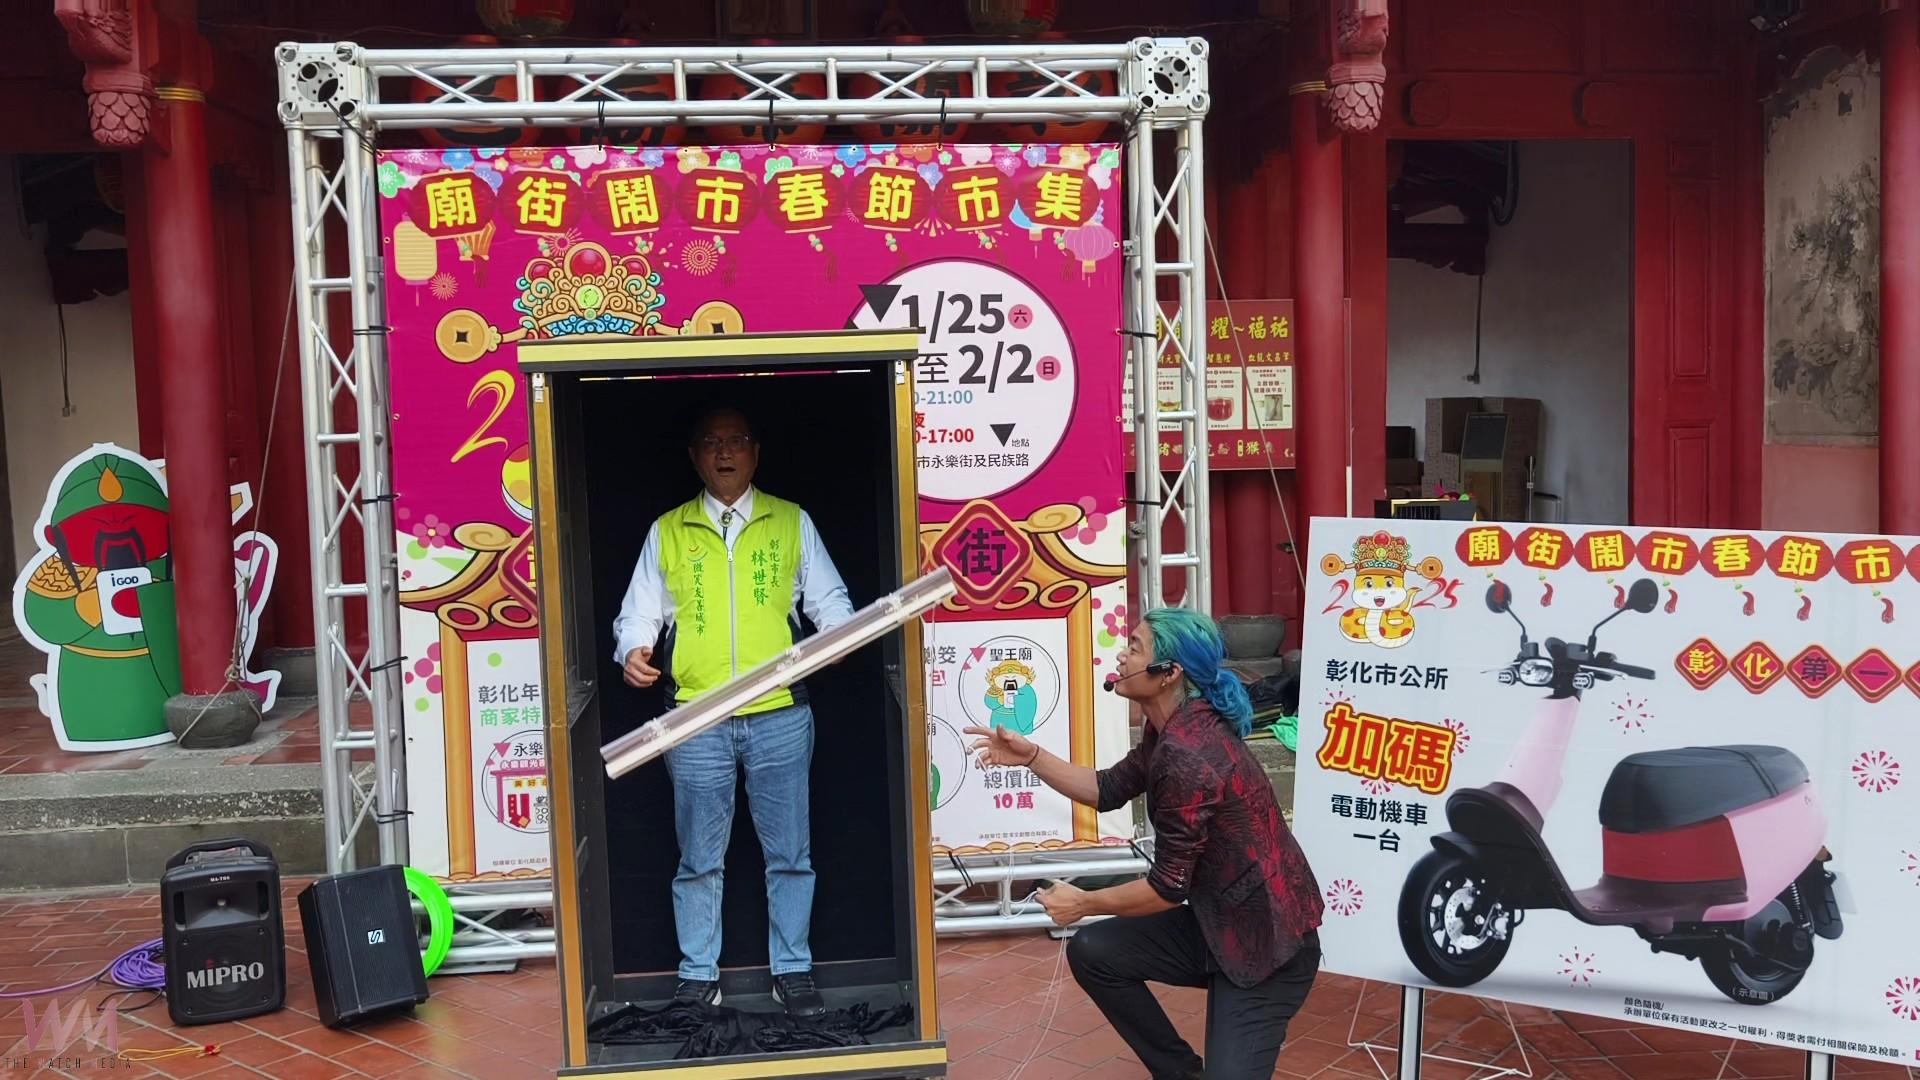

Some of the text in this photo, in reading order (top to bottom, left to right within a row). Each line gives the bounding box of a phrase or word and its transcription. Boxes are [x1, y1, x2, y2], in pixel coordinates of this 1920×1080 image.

[425, 171, 1083, 229] 廟街鬧市春節市集
[901, 291, 1028, 343] 1/25 六
[917, 341, 1055, 393] 至 2/2 日
[1012, 438, 1030, 448] 地點
[917, 453, 1030, 468] 市永樂街及民族路
[769, 539, 780, 588] 彰化市長
[957, 528, 1006, 576] 街
[1468, 529, 1891, 580] 廟街鬧市春節市
[751, 550, 769, 606] 林世賢
[990, 648, 1033, 662] 聖王廟
[1687, 648, 1889, 682] 彰化第一
[1326, 659, 1448, 690] 彰化市公所
[478, 683, 540, 704] 彰化年
[480, 706, 541, 727] 商家特
[514, 742, 544, 757] 永樂
[1317, 704, 1455, 794] 加碼
[1331, 794, 1428, 826] 電動機車
[1353, 829, 1401, 853] 一台
